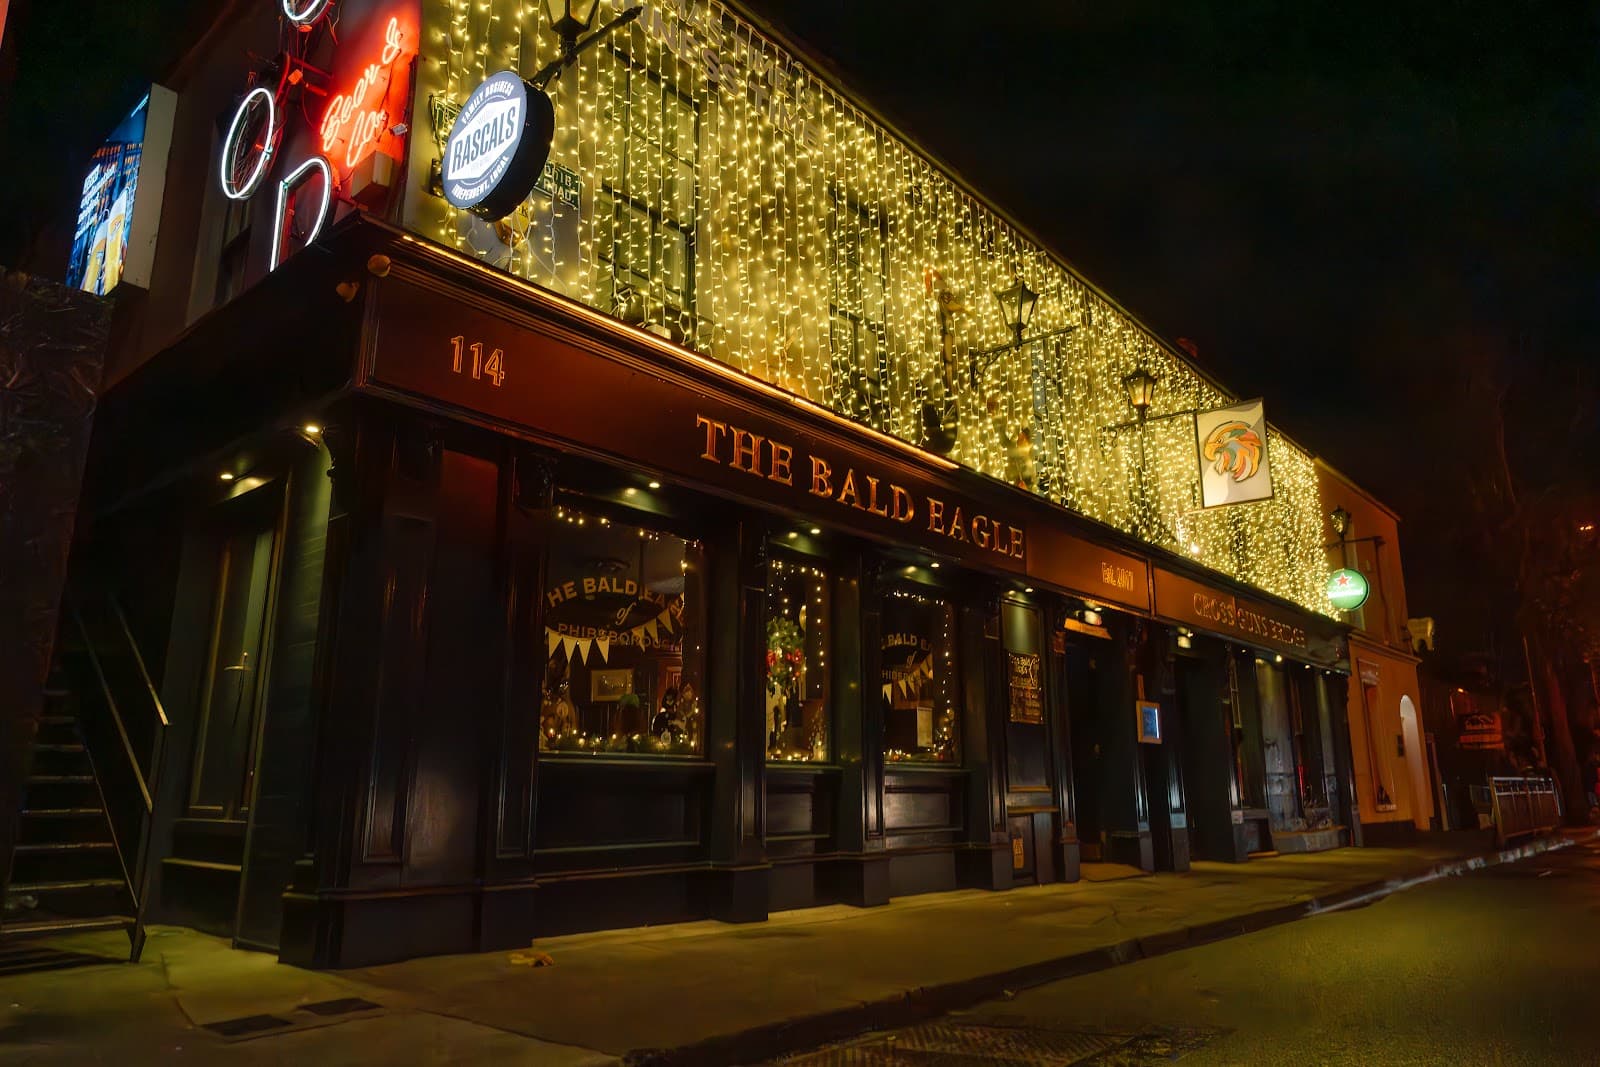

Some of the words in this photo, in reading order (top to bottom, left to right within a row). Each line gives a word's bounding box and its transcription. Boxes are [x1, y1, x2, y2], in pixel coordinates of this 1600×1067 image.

[462, 91, 484, 124] FAMILY
[452, 106, 516, 173] RASCALS
[489, 156, 510, 183] LOCAL
[544, 178, 572, 202] ROAD
[450, 335, 505, 387] 114
[696, 413, 793, 487] THE
[808, 454, 915, 523] BALD
[926, 496, 1025, 559] EAGLE
[546, 580, 578, 608] HE
[583, 576, 638, 597] BALD
[615, 601, 637, 626] of
